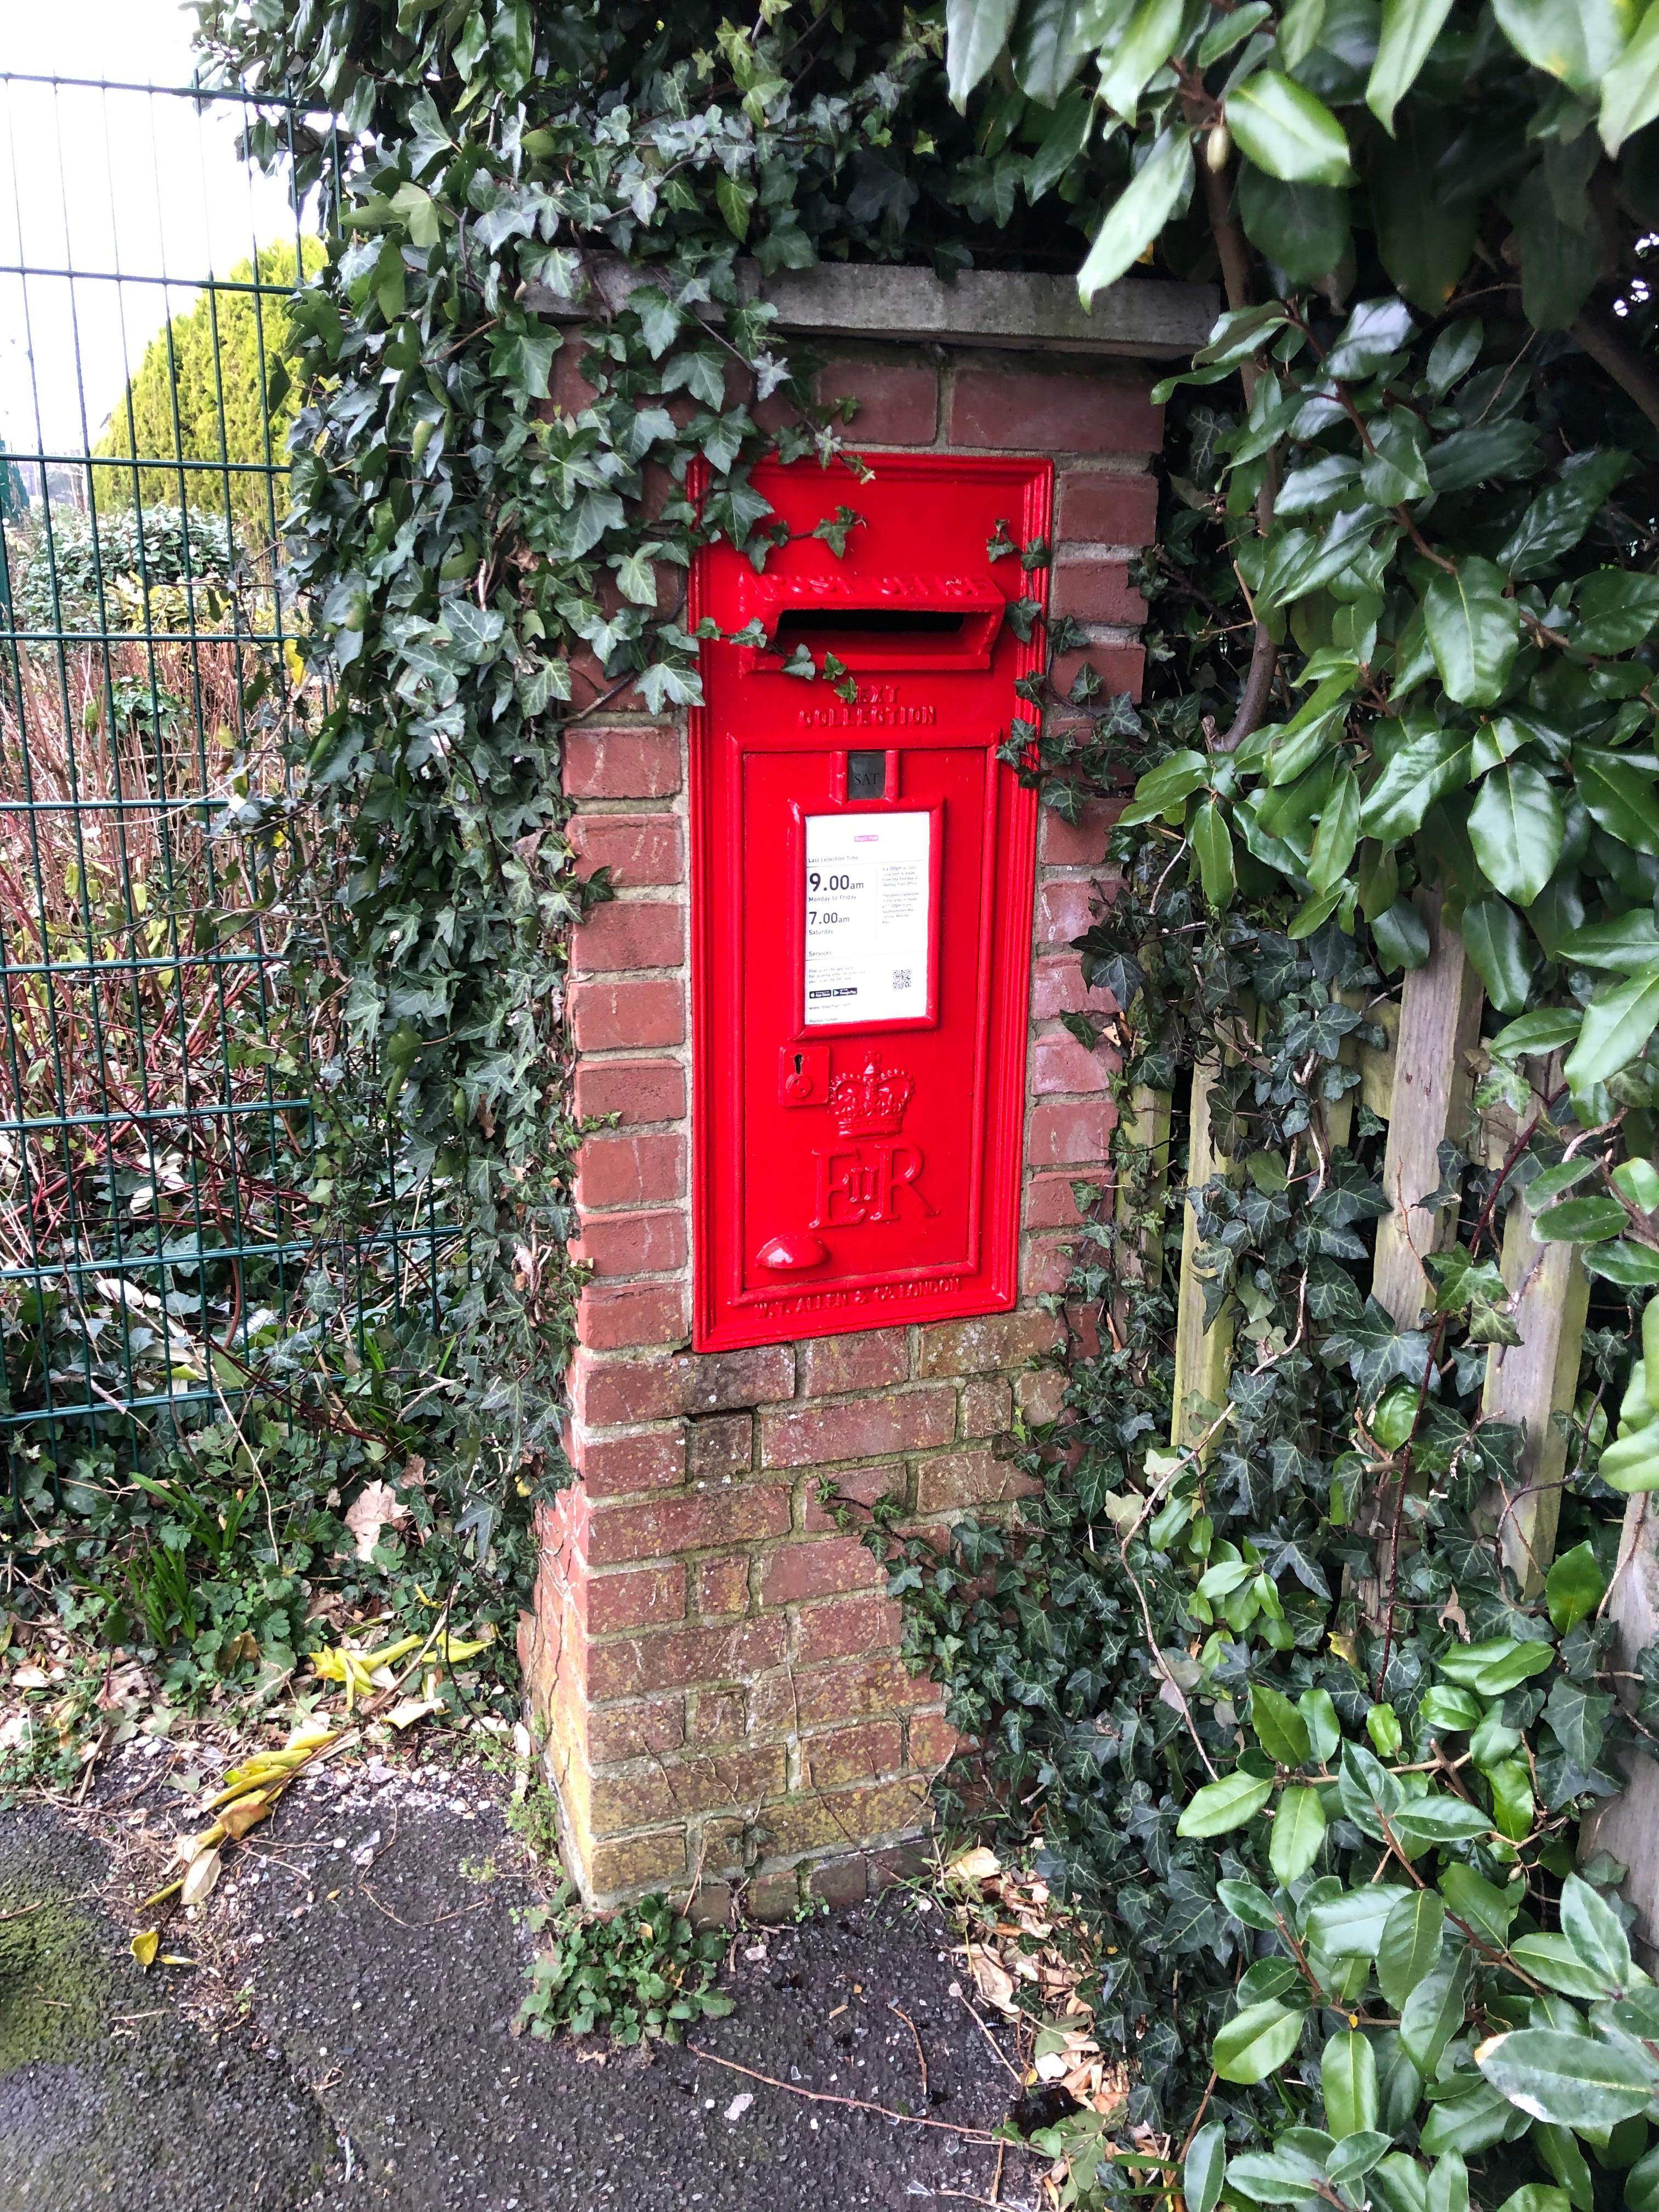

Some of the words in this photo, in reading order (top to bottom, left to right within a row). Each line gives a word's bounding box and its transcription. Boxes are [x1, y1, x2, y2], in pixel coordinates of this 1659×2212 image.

[763, 573, 855, 595] POST
[876, 574, 988, 597] OFFICE
[840, 685, 899, 703] EXT
[799, 706, 937, 728] COLLECTION
[854, 772, 879, 786] SAT
[809, 872, 864, 892] 9.00am
[809, 911, 850, 925] 7.00am
[797, 1291, 848, 1312] ALLEN
[854, 1290, 868, 1304] &
[899, 1277, 961, 1299] LONDON
